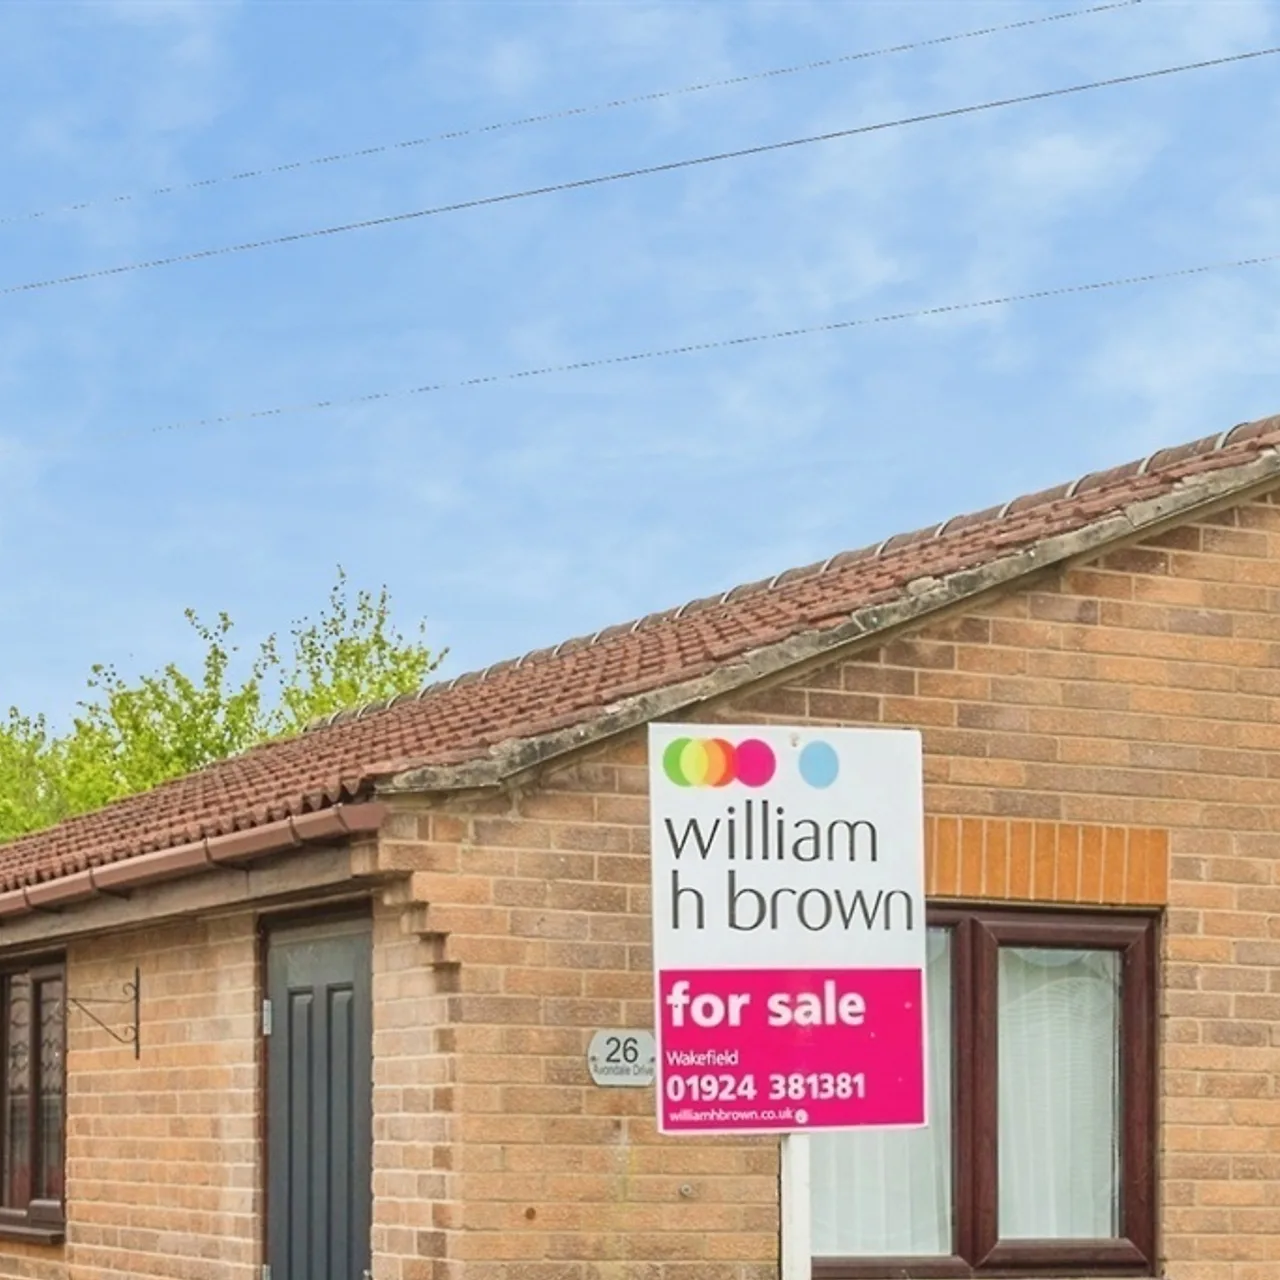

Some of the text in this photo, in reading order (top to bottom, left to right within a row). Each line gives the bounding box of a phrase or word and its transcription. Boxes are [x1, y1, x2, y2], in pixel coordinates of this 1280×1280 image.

[664, 799, 878, 862] william
[671, 869, 913, 931] h brown
[665, 980, 865, 1027] for sale
[606, 1037, 638, 1063] 26
[666, 1049, 739, 1066] Wakefield
[666, 1073, 865, 1101] 01924 381381
[669, 1107, 793, 1123] williamhbrown.co.uk
